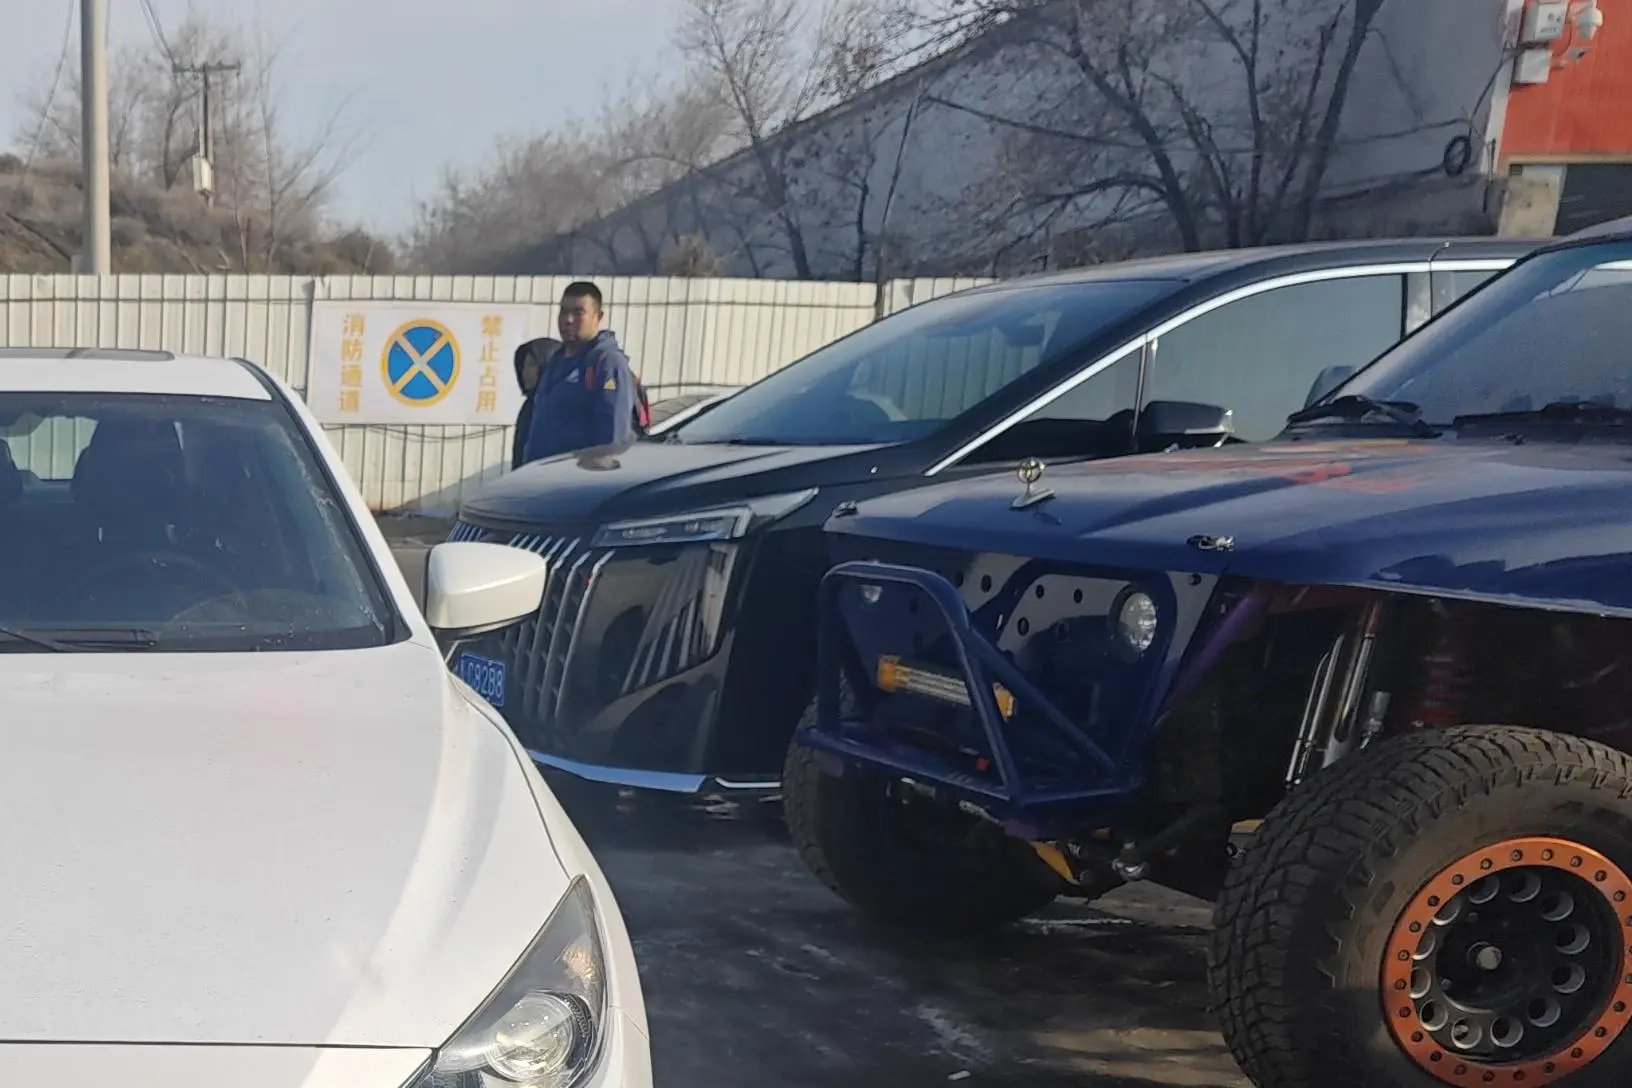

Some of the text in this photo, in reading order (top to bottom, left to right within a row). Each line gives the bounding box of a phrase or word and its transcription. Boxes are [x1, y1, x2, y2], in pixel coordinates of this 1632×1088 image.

[338, 312, 364, 412] 消防通道
[475, 314, 503, 412] 禁止占用
